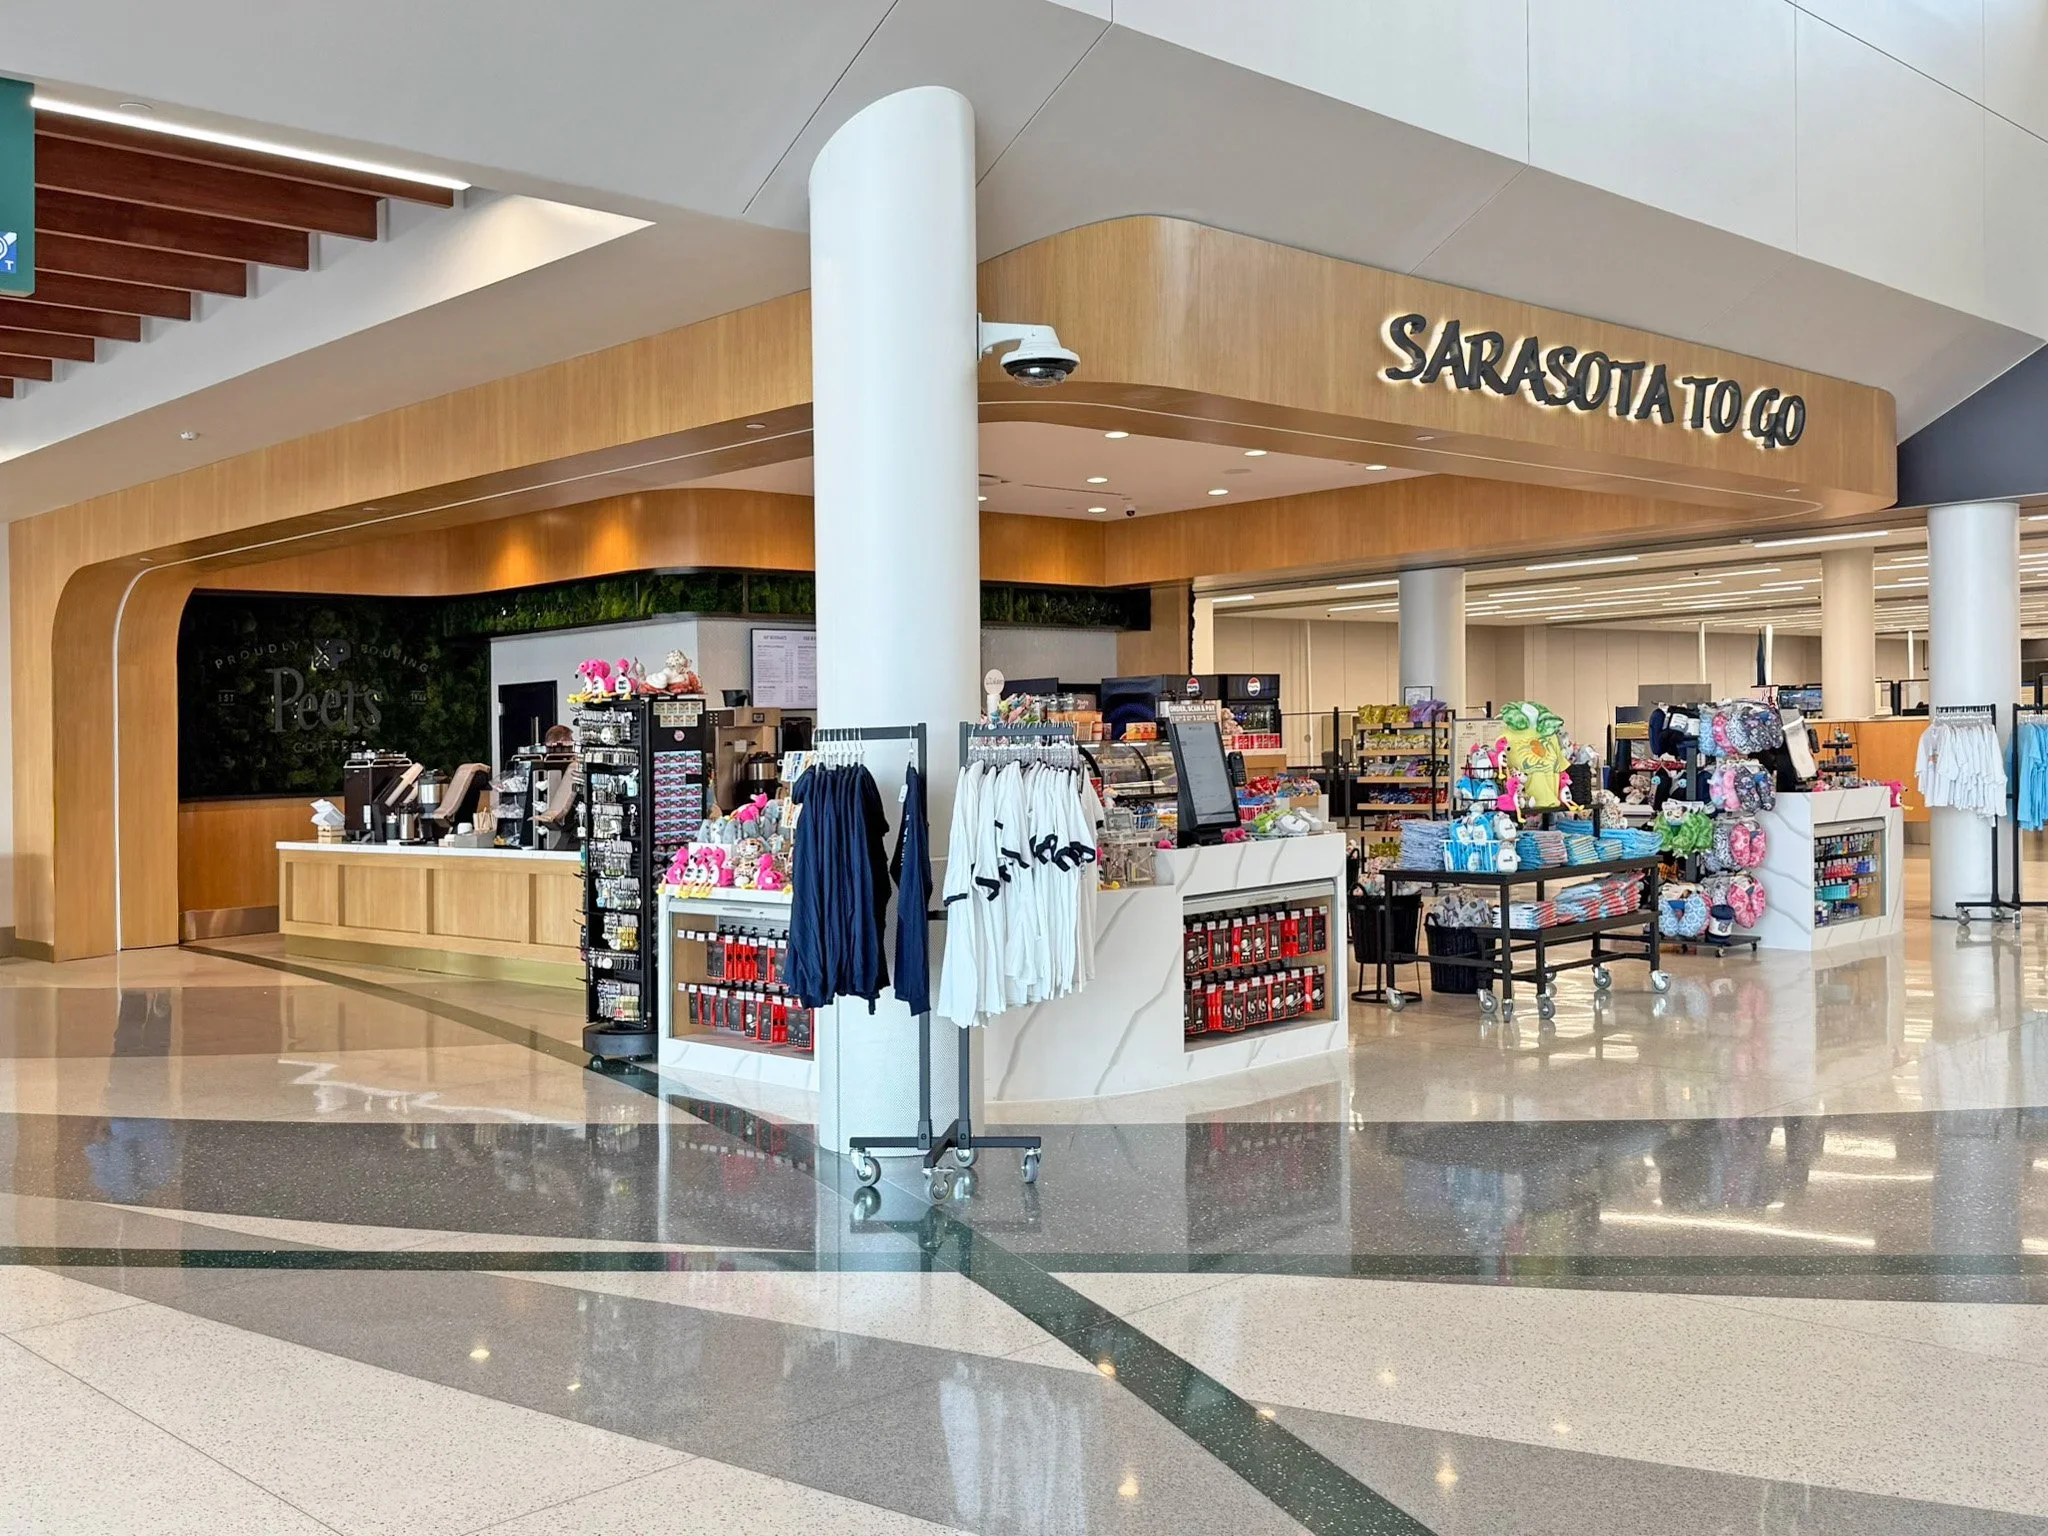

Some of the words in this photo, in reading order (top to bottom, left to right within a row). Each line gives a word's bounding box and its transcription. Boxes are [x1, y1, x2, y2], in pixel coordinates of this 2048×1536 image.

[1385, 313, 1674, 424] SARASOTA
[1682, 376, 1742, 434] TO
[1748, 387, 1807, 449] GO
[214, 641, 301, 670] PROUDLY
[293, 740, 360, 754] COFFEE
